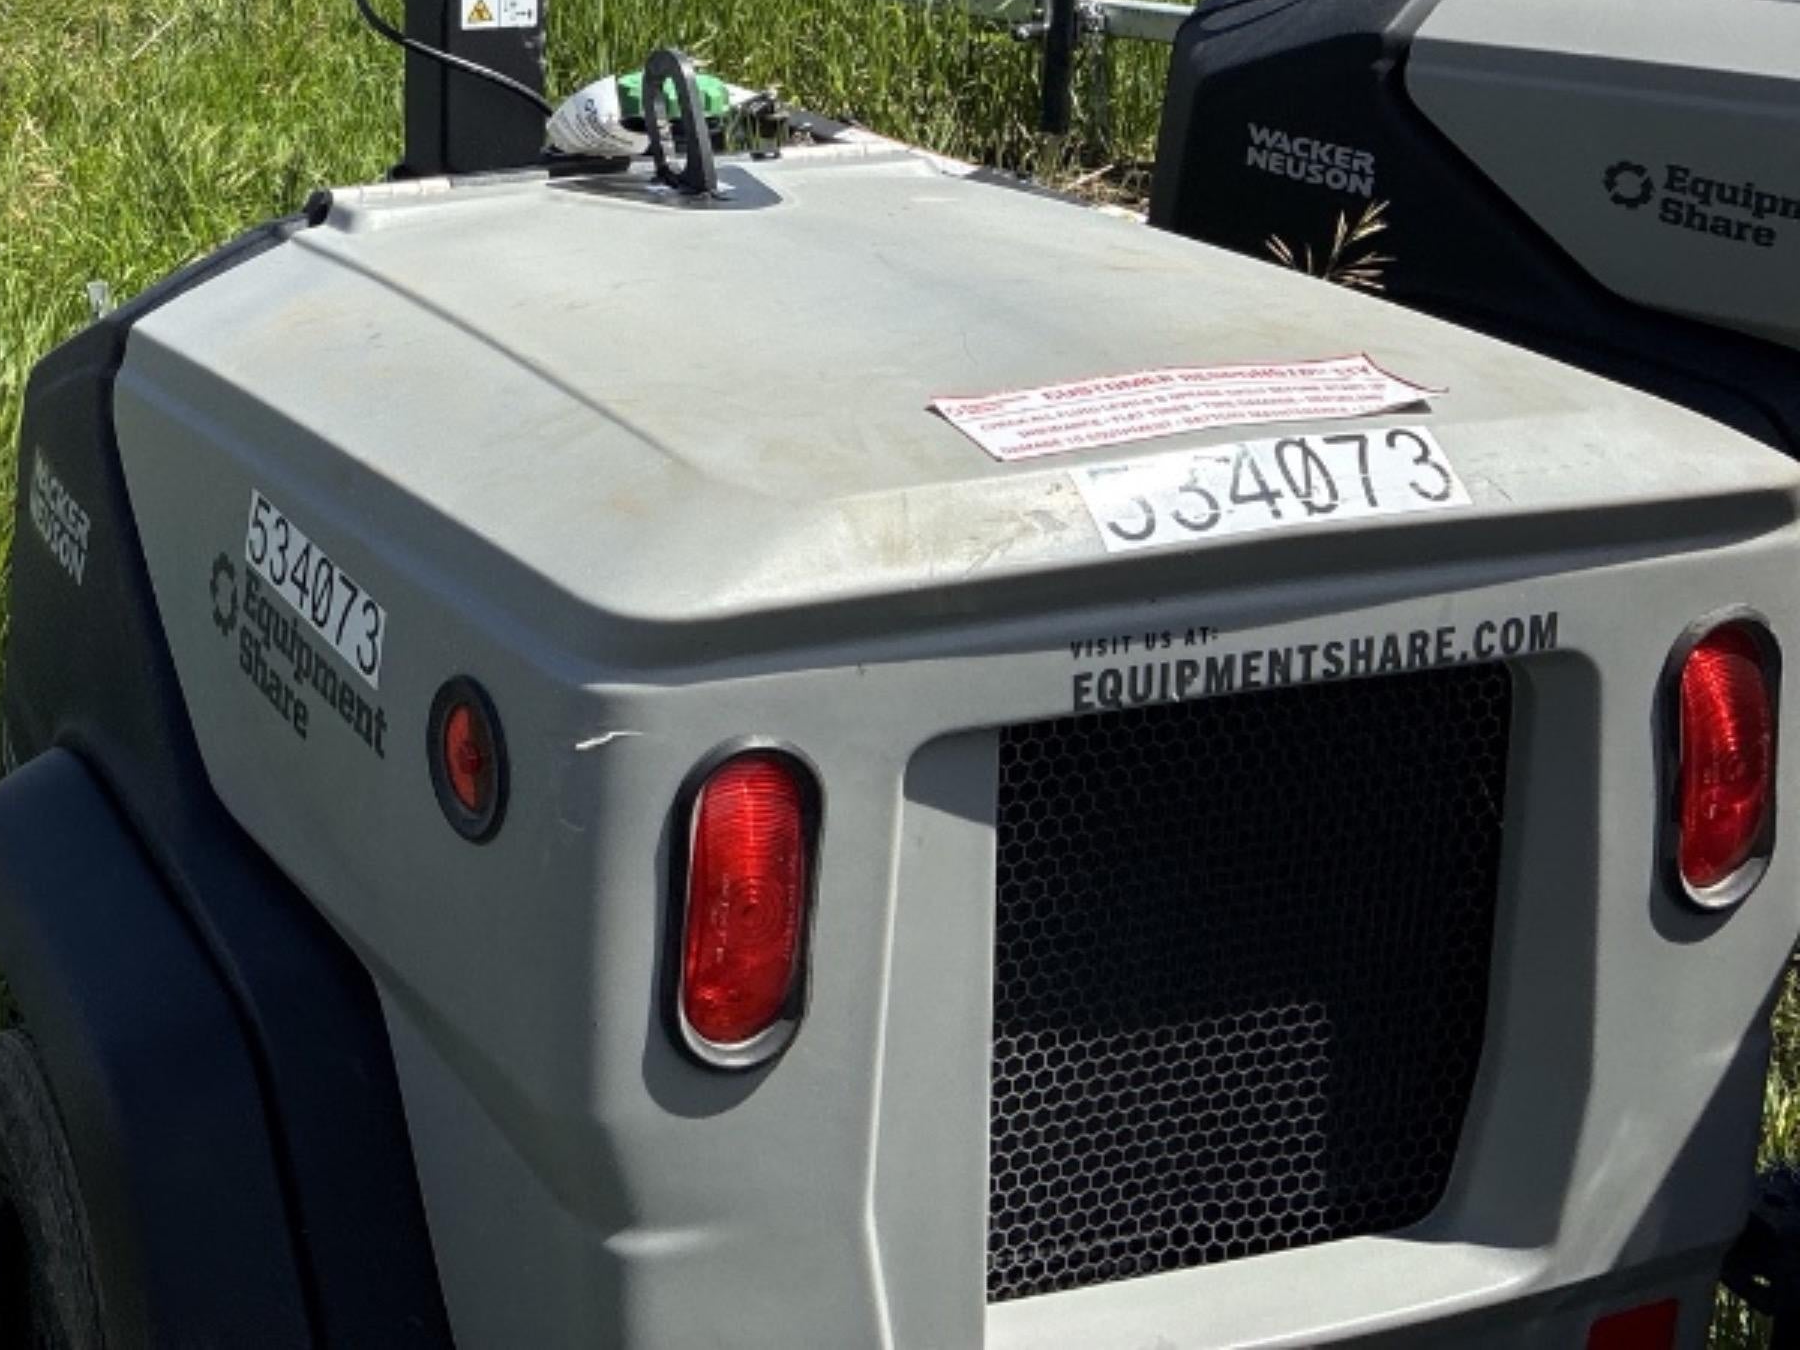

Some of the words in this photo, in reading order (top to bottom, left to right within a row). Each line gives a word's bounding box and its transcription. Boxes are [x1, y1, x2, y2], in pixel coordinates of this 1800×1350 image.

[1247, 146, 1376, 199] NEUSON
[1248, 122, 1376, 176] WACKER
[1659, 197, 1777, 247] Share
[248, 496, 379, 676] 534073
[244, 565, 387, 760] Equipment
[1070, 634, 1132, 659] VISIT
[1144, 632, 1172, 652] US
[1184, 626, 1219, 646] AT:
[1072, 611, 1559, 712] EQUIPMENTSHARE.COM
[239, 625, 309, 741] Share
